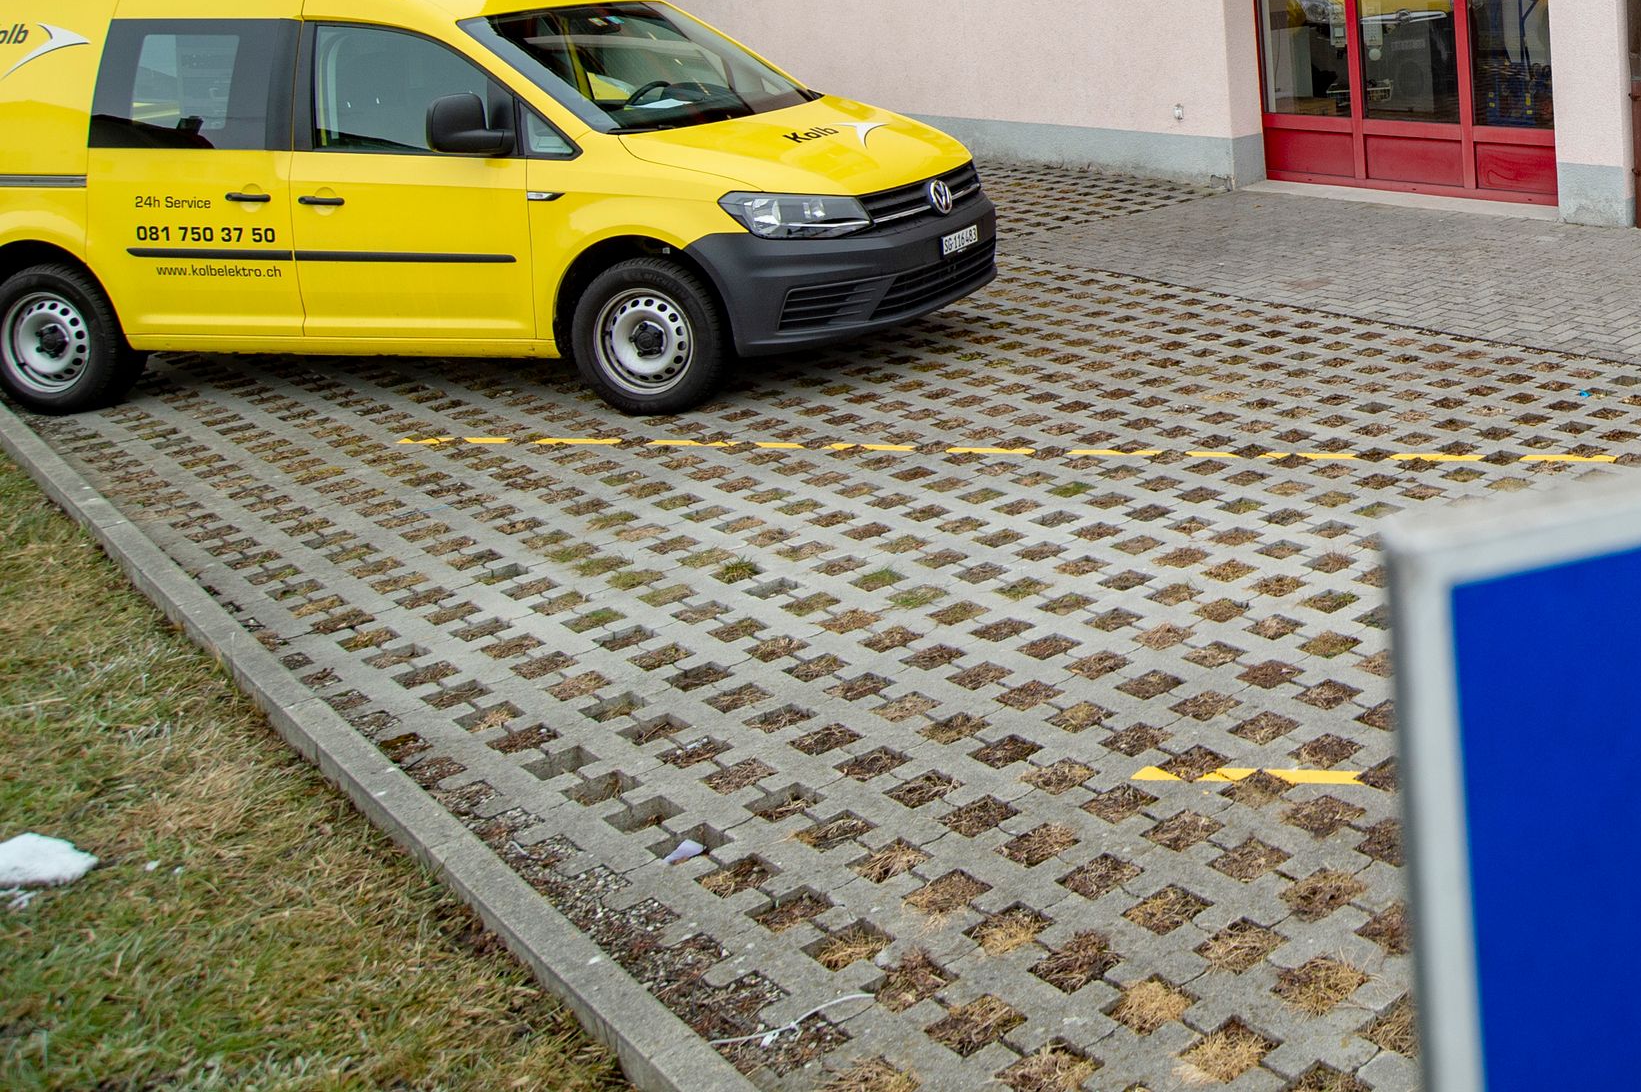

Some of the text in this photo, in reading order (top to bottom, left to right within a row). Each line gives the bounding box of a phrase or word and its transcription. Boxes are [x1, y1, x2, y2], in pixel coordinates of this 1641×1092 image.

[0, 23, 29, 45] olb
[782, 126, 840, 144] Kolb
[135, 195, 211, 209] 24h Service
[136, 225, 276, 243] 081 750 37 50
[156, 263, 282, 278] www.kolbelektro.ch
